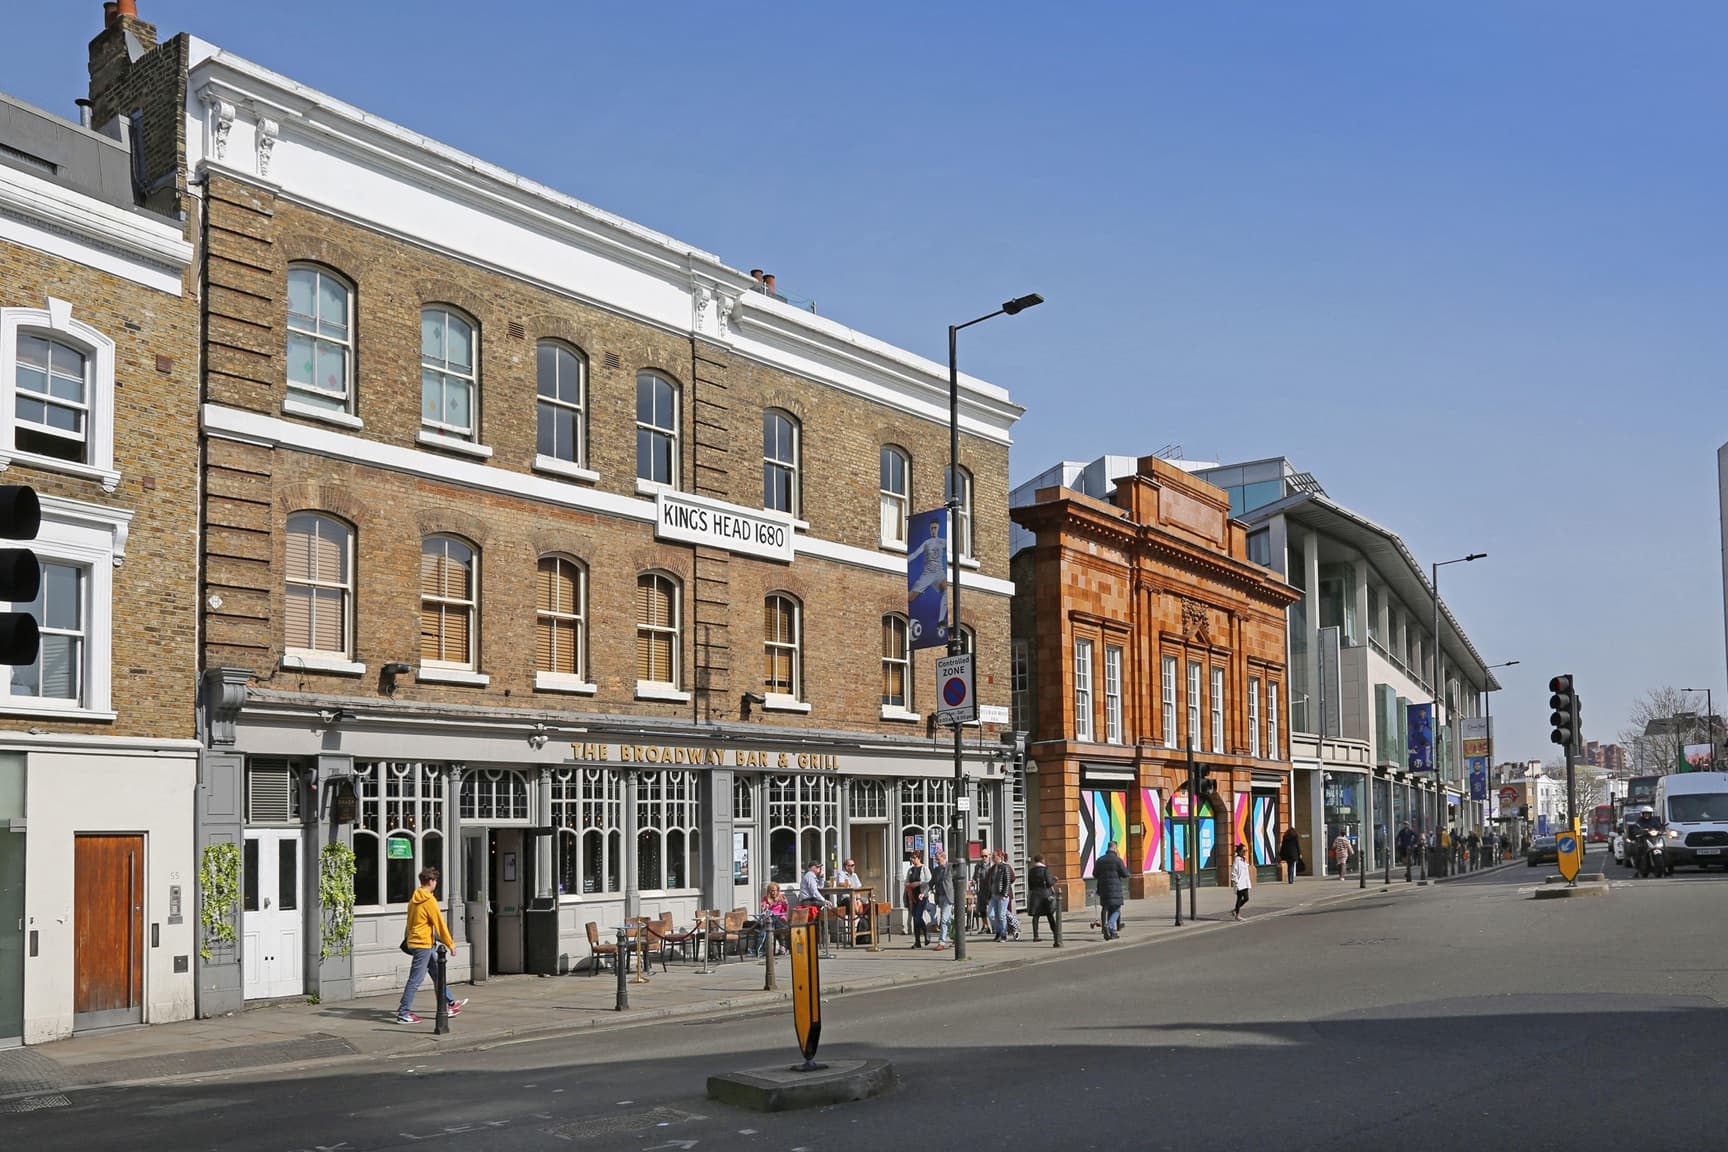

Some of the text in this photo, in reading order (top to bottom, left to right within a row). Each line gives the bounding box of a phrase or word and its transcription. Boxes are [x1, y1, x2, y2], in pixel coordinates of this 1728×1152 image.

[664, 503, 784, 547] KING'S HEAD 1680
[938, 656, 970, 668] Controlled
[943, 666, 965, 676] ZONE
[571, 742, 840, 770] THE BROADWAY BAR & GRILL
